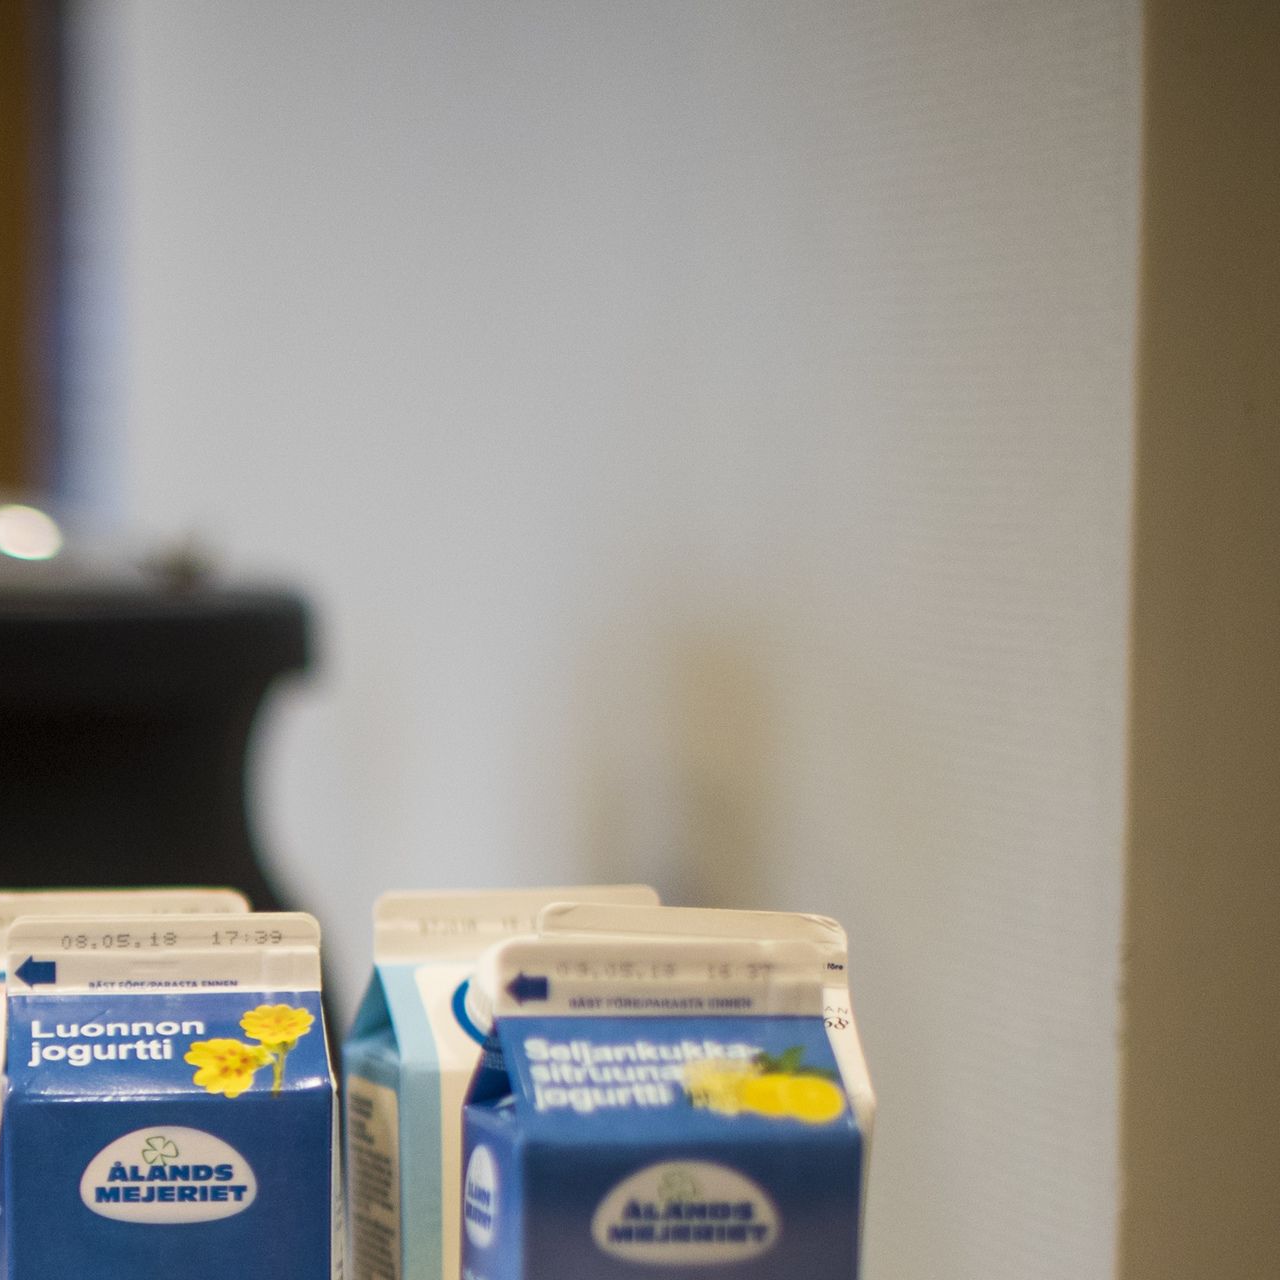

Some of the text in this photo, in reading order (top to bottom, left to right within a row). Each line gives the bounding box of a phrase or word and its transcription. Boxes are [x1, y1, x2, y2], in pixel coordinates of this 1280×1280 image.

[61, 930, 283, 950] 08.05.18 17:39
[30, 1020, 205, 1039] Luonnon
[28, 1038, 173, 1068] jogurtti
[106, 1161, 234, 1183] ÅLANDS
[94, 1184, 249, 1203] MEJERIET
